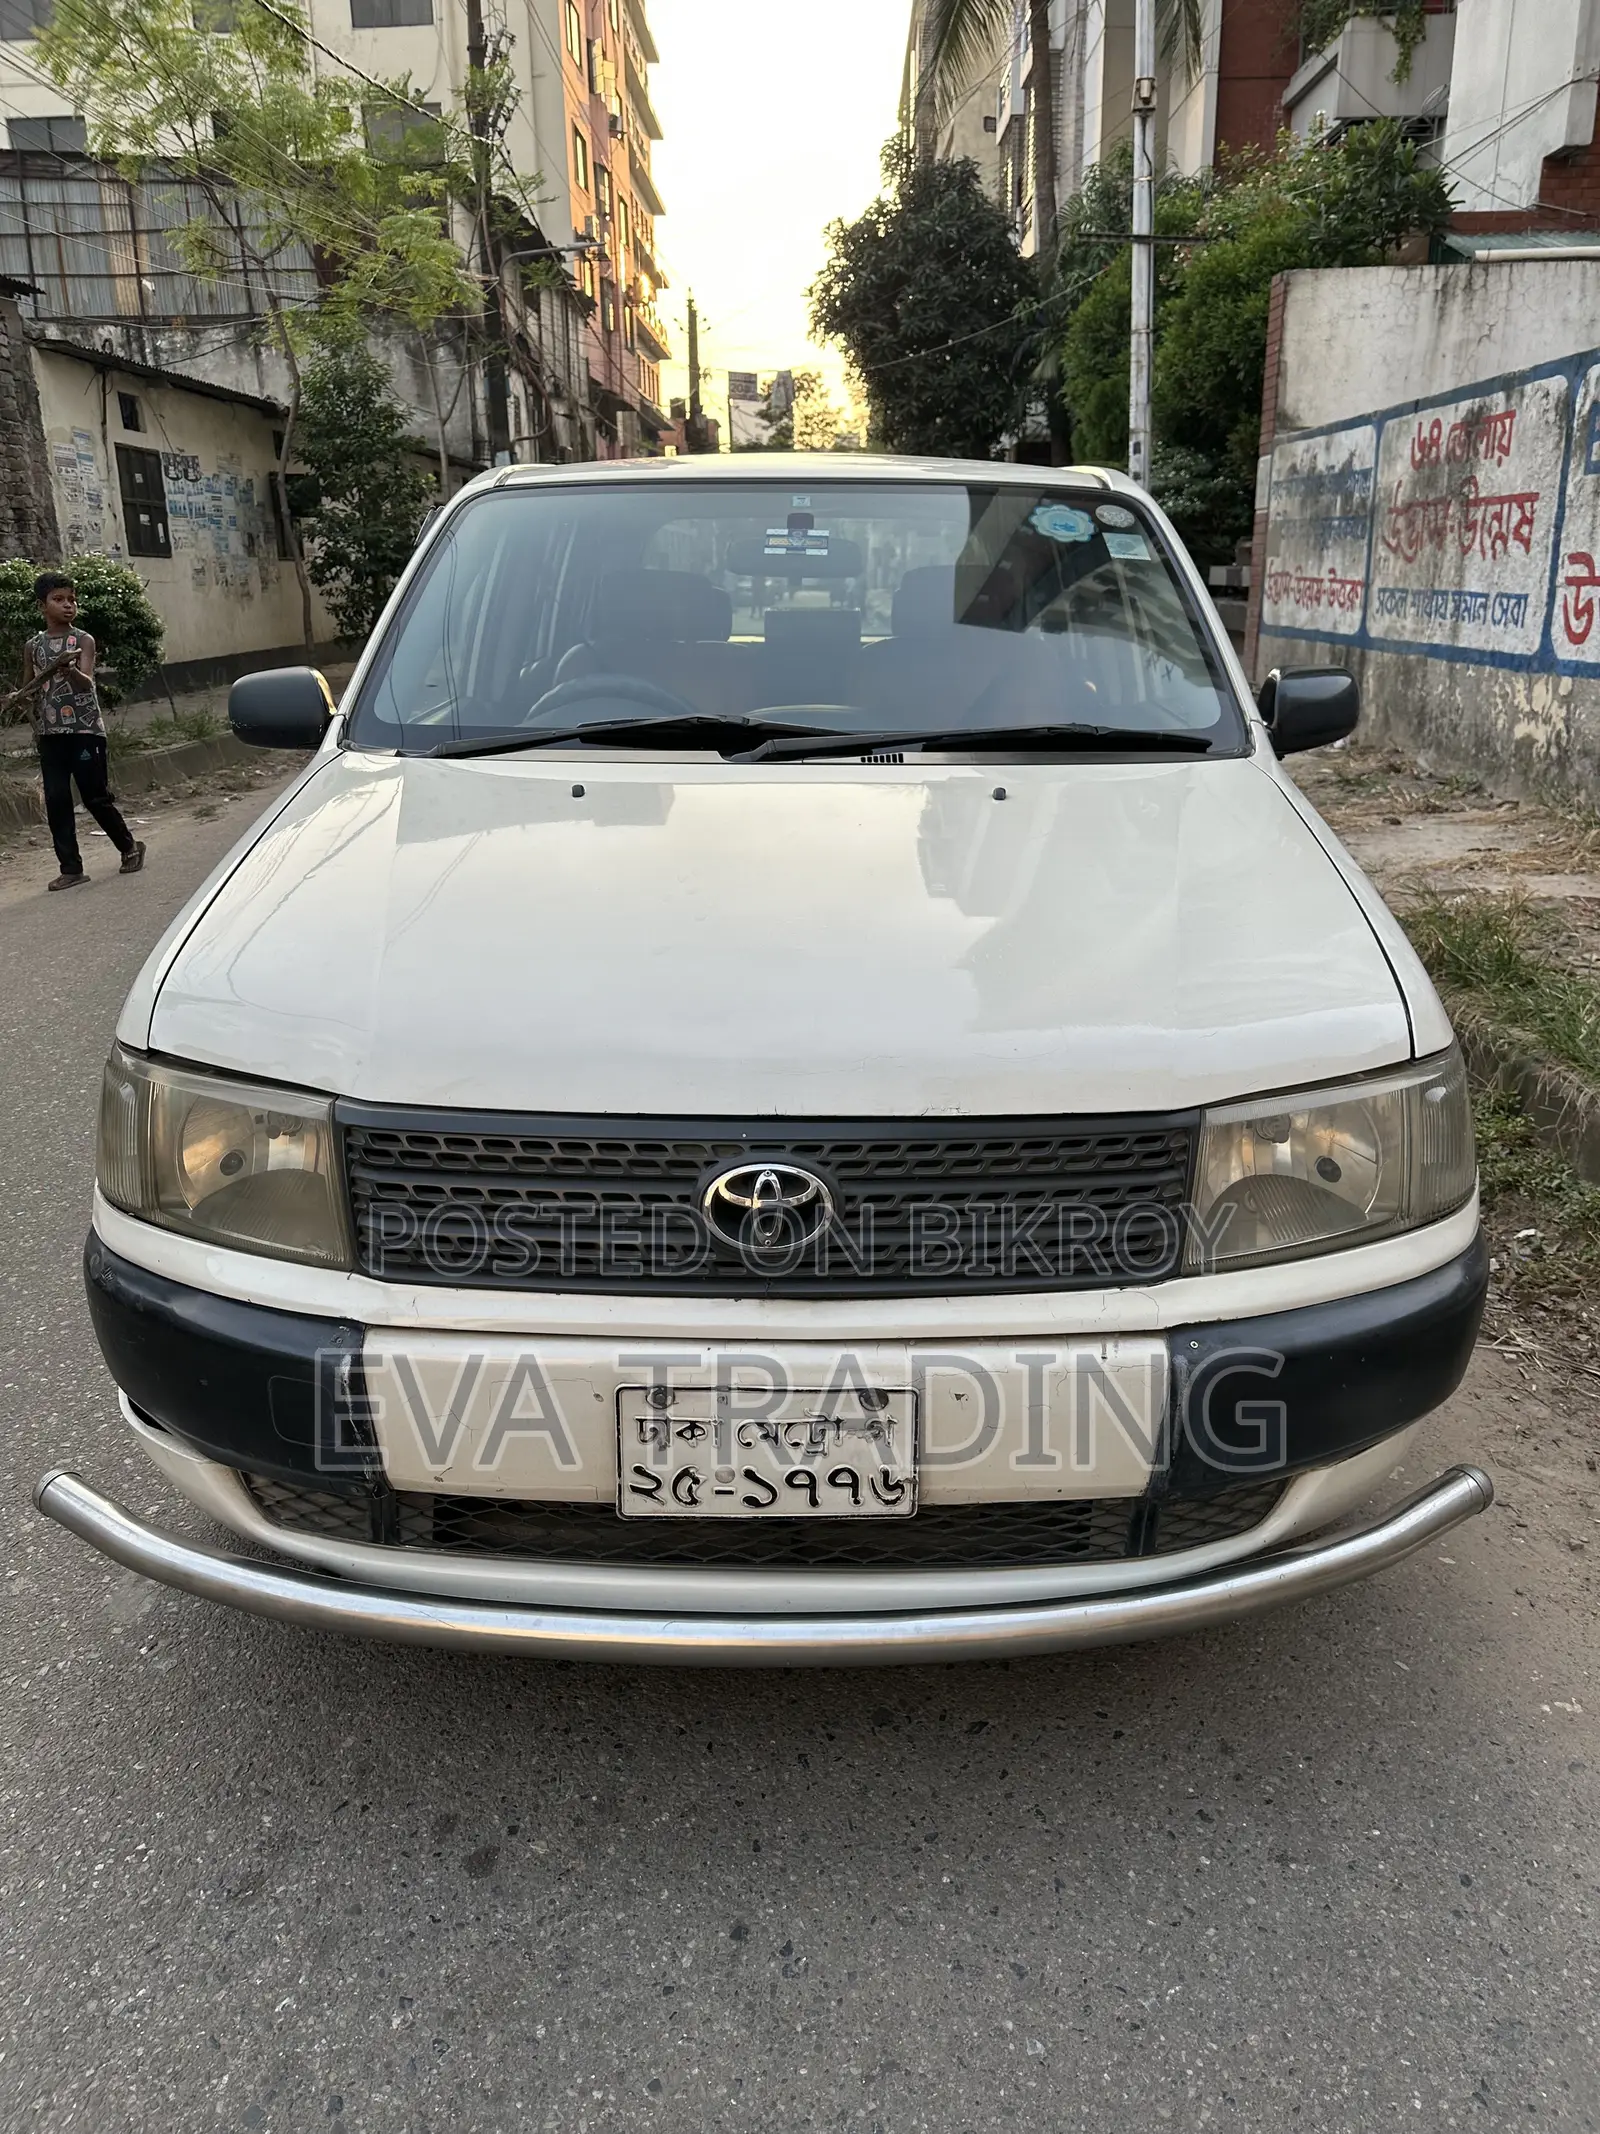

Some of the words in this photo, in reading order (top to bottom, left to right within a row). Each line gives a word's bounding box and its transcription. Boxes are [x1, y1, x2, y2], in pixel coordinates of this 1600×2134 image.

[1410, 418, 1442, 472] ৬৪
[1446, 409, 1517, 468] জেলায়
[1491, 592, 1529, 629] সেবা
[1564, 552, 1600, 646] উ
[634, 1415, 722, 1450] ঢাকা
[628, 1464, 906, 1508] ২৫-১৭৭৬
